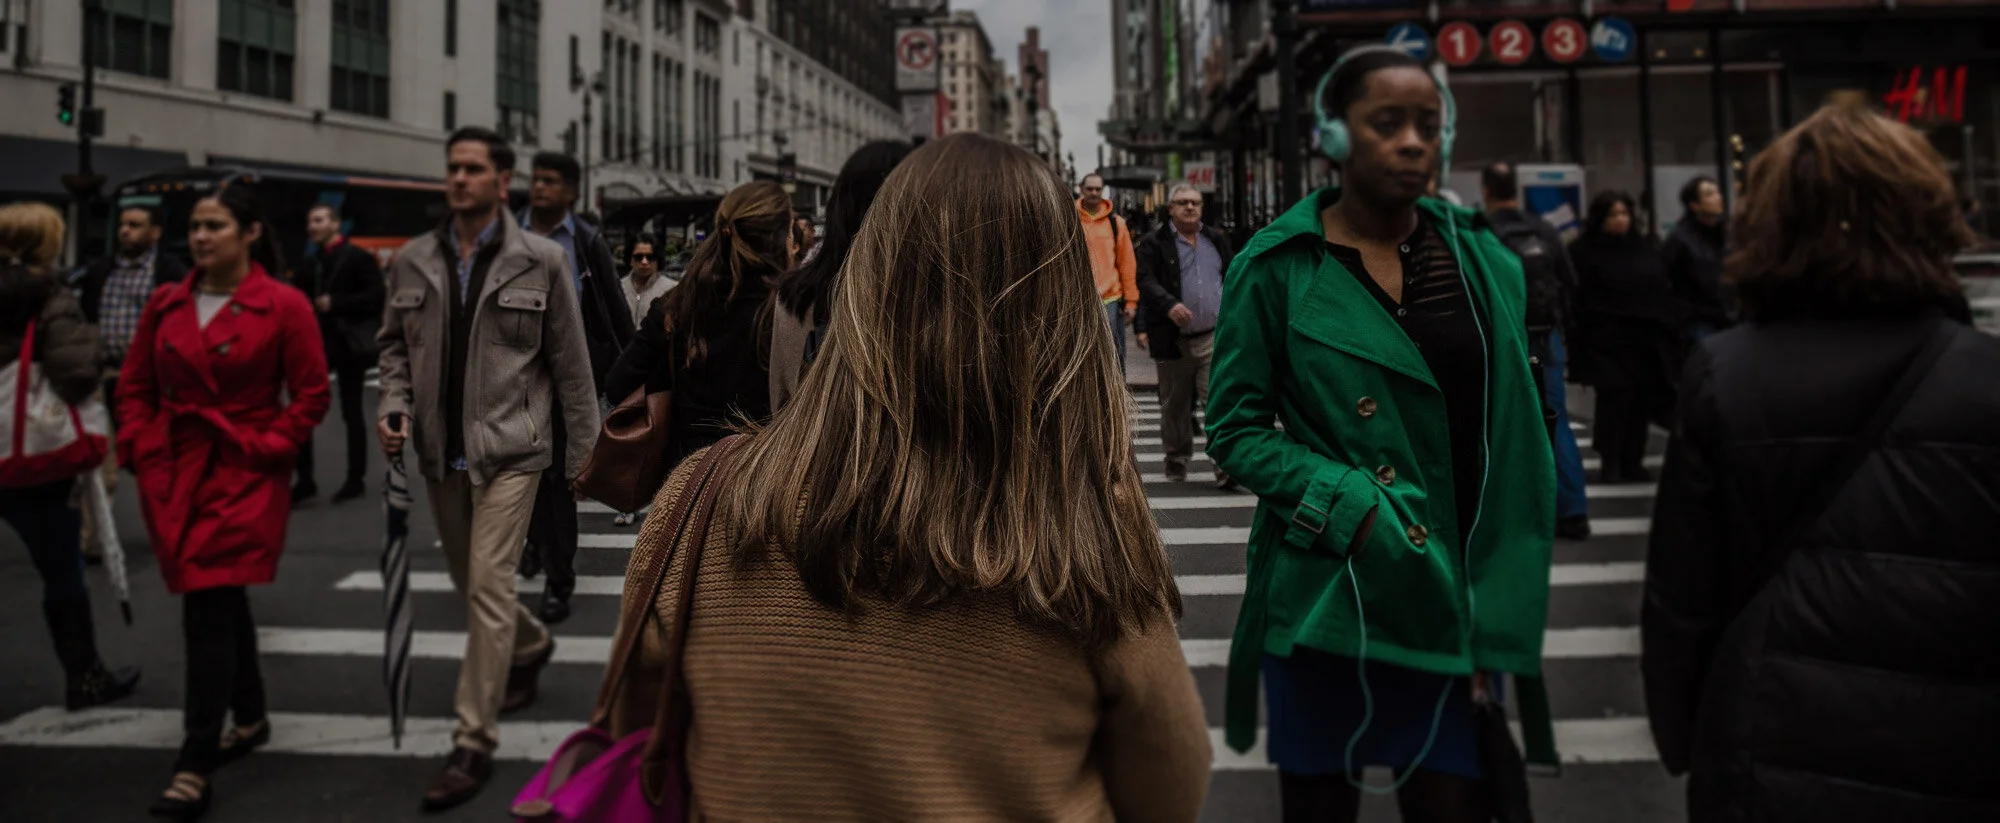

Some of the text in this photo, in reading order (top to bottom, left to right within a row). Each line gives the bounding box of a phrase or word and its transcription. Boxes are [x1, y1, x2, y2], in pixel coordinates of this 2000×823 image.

[1449, 24, 1577, 58] 1 2 3
